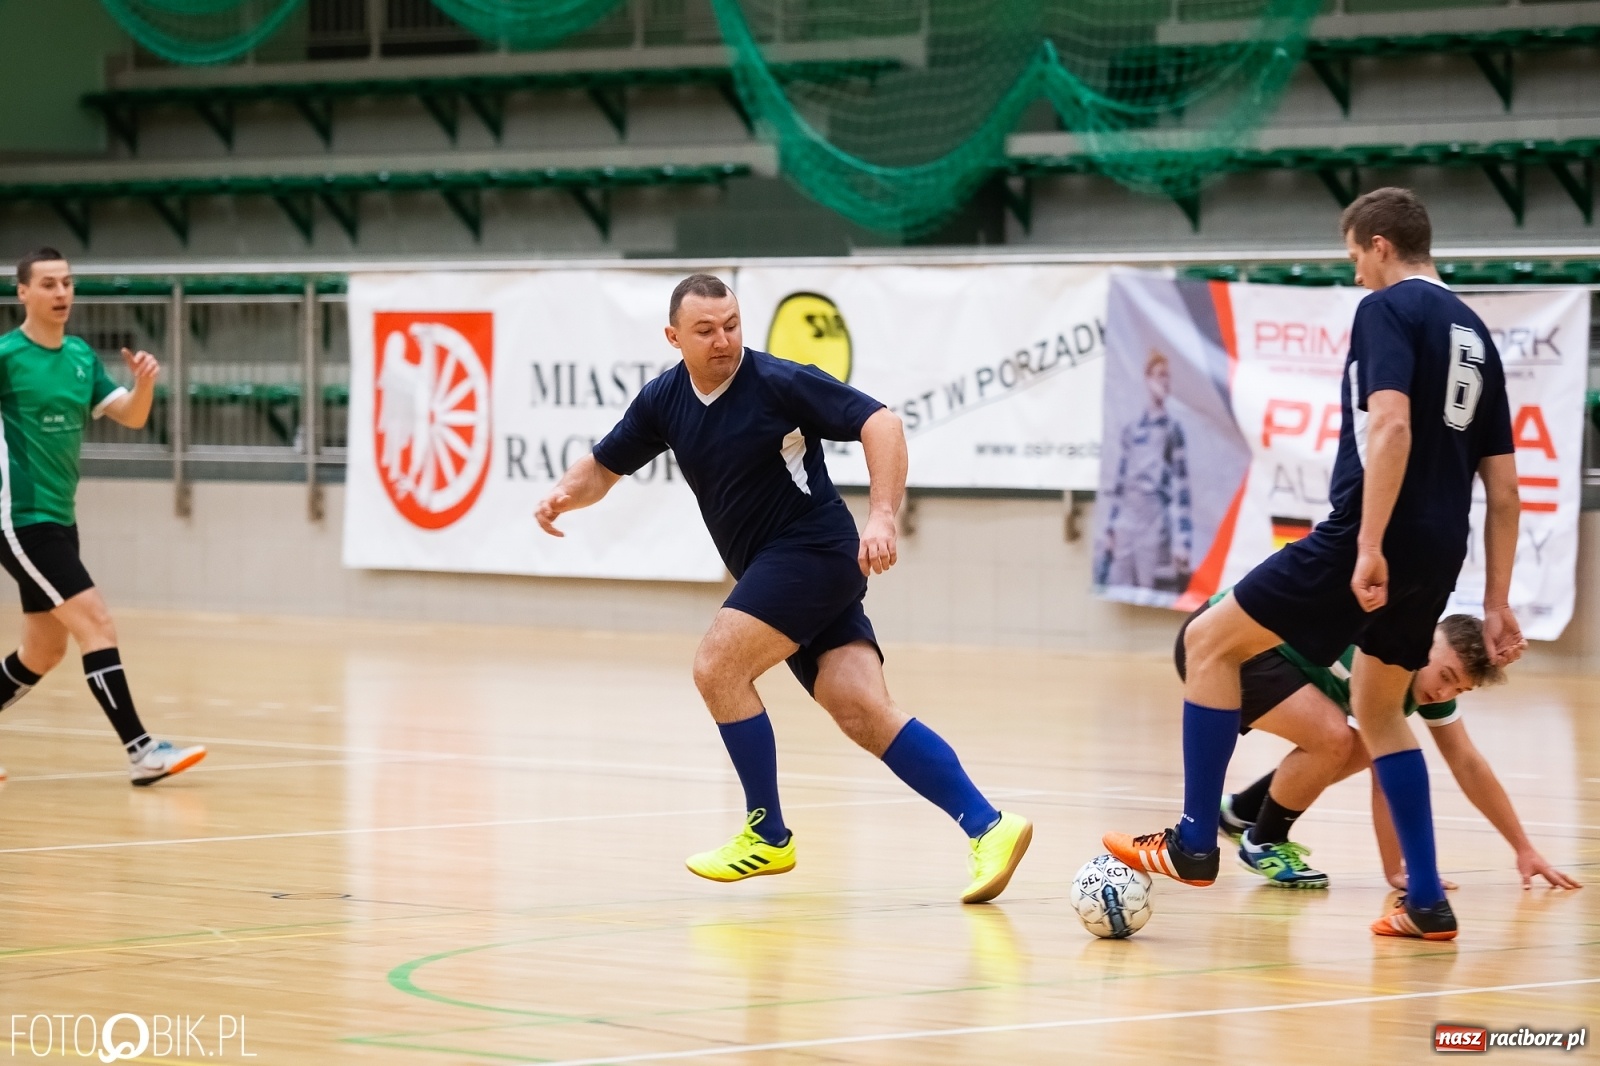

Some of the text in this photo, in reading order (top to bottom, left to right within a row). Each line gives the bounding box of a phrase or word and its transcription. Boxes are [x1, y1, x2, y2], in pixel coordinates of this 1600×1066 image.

[1254, 320, 1350, 355] PRIM
[530, 361, 680, 408] MIAST
[944, 375, 966, 411] W
[1443, 323, 1486, 432] 6
